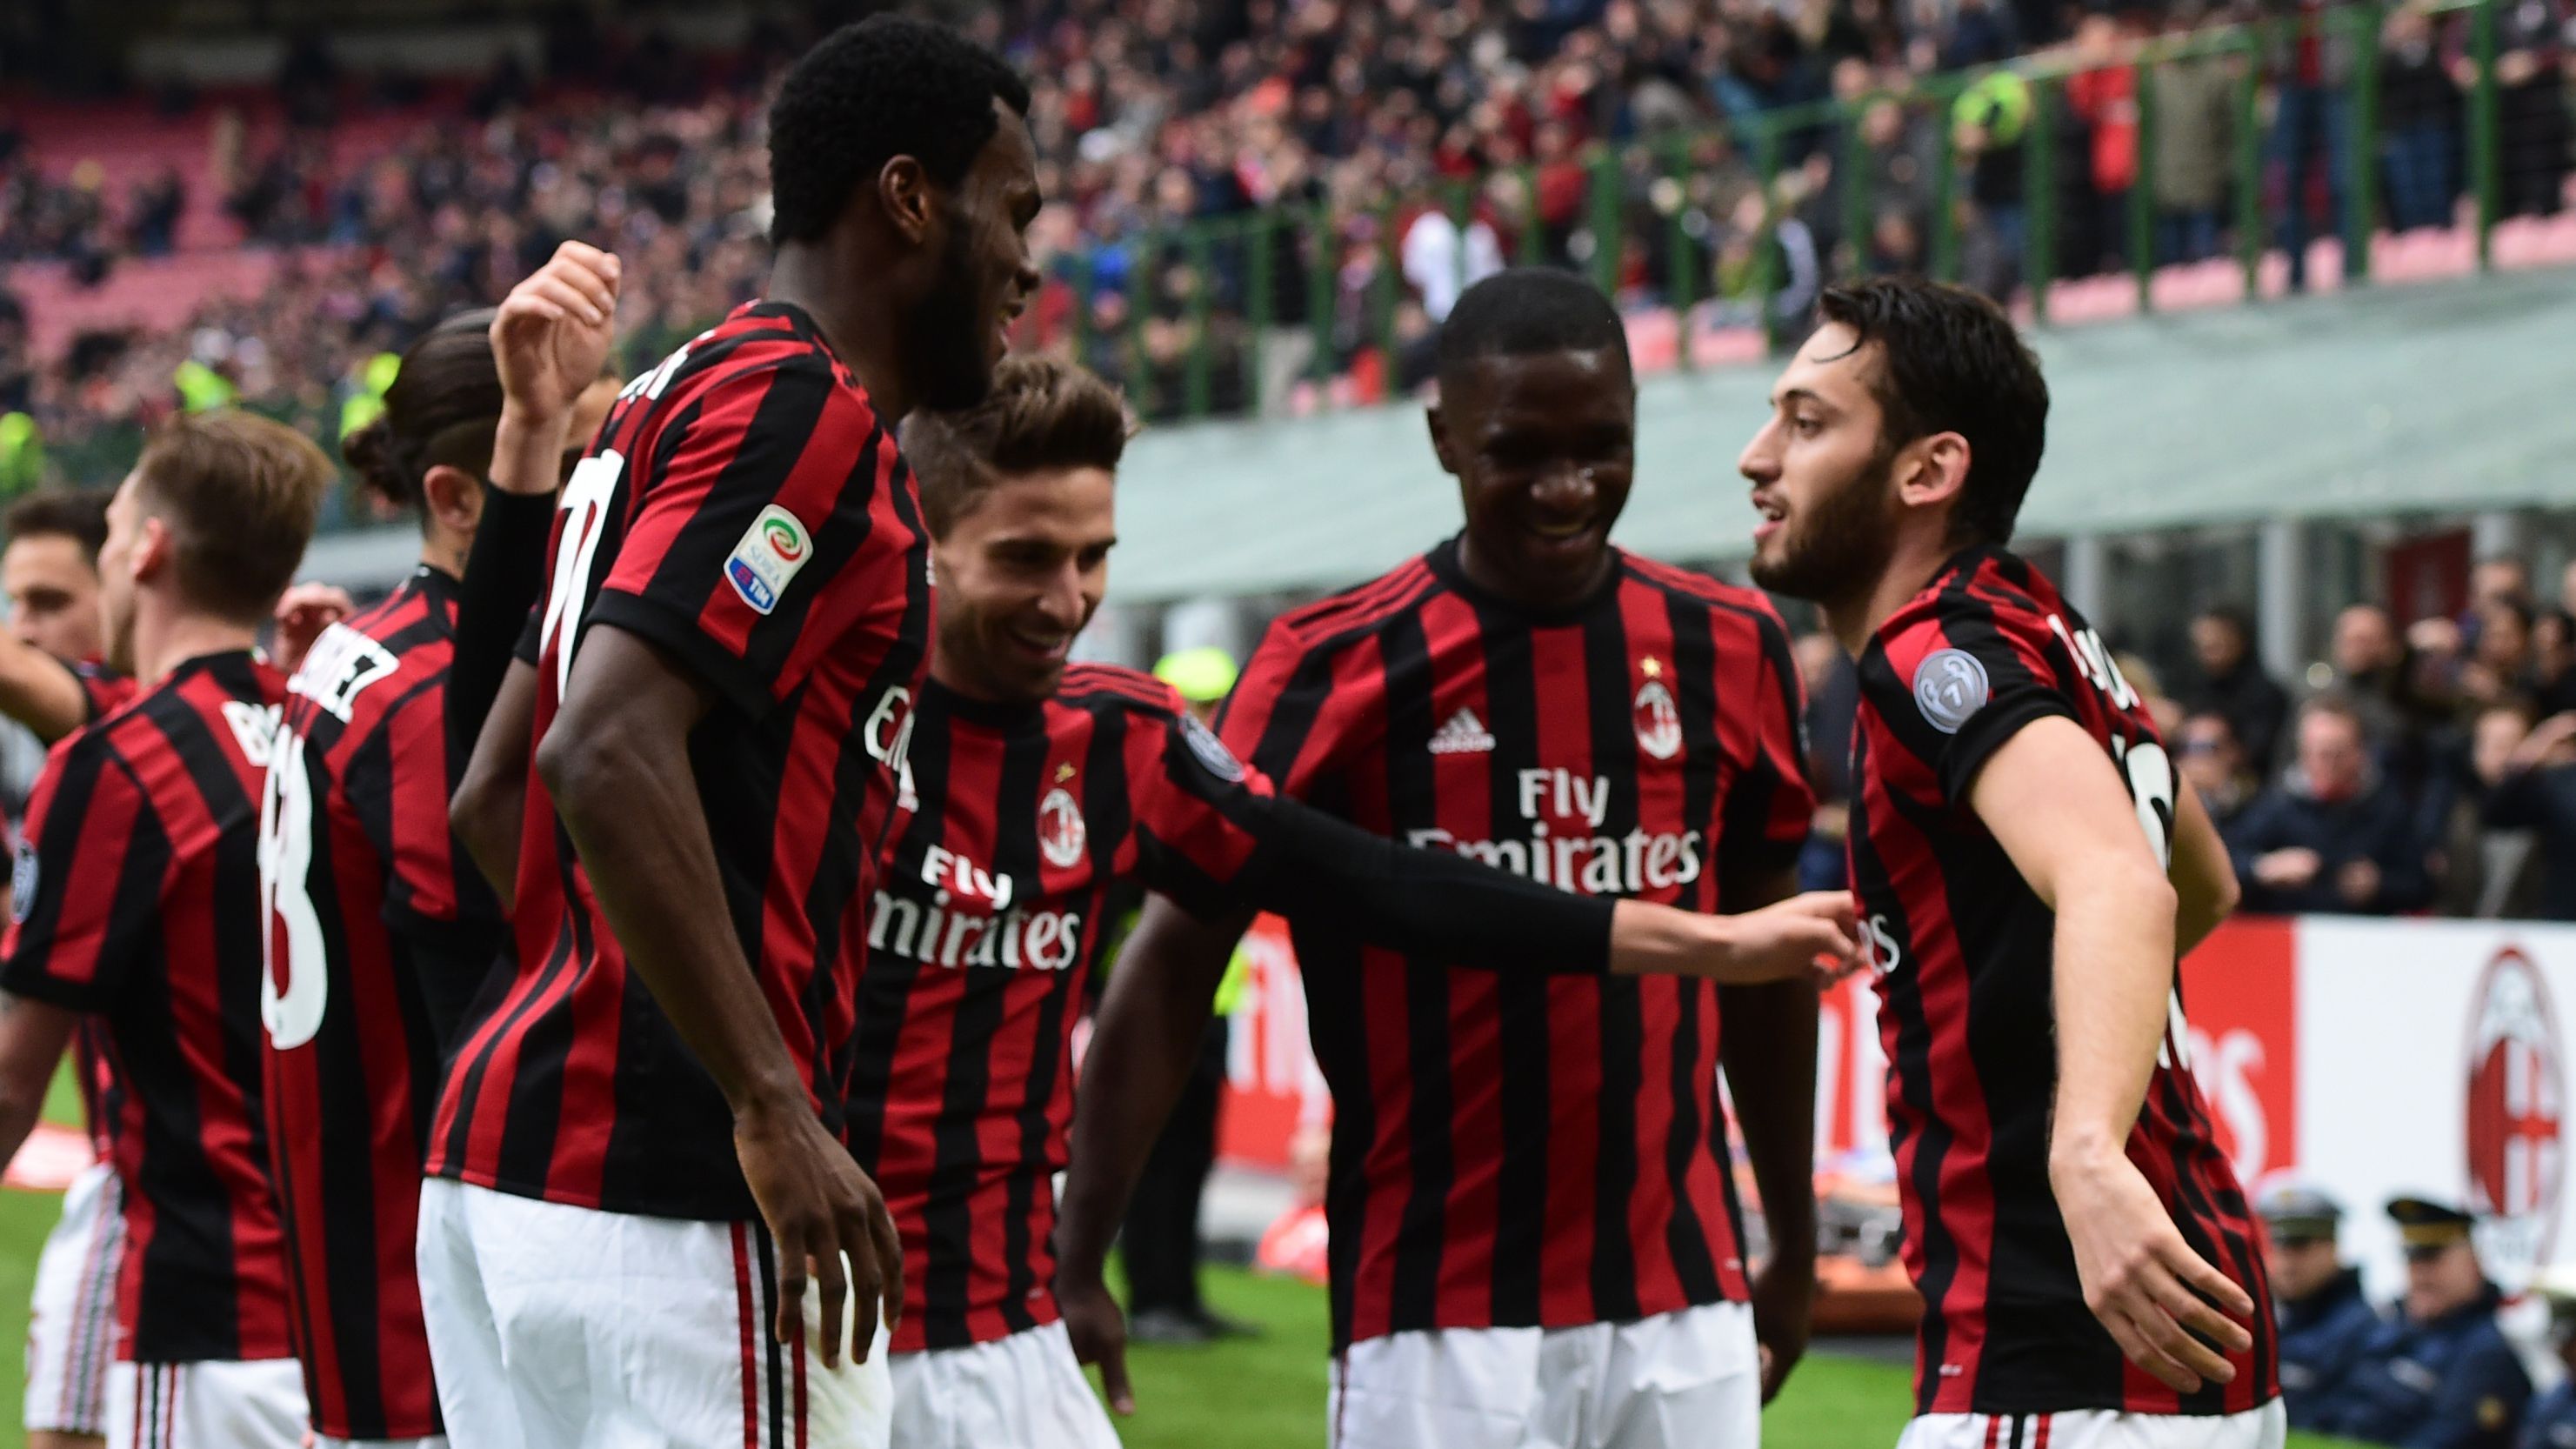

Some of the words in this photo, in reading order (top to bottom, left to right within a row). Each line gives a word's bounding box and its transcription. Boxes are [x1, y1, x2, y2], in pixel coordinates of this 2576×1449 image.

[1518, 766, 1610, 827] Fly
[921, 844, 1012, 911] Fly
[866, 889, 1080, 971] mirates
